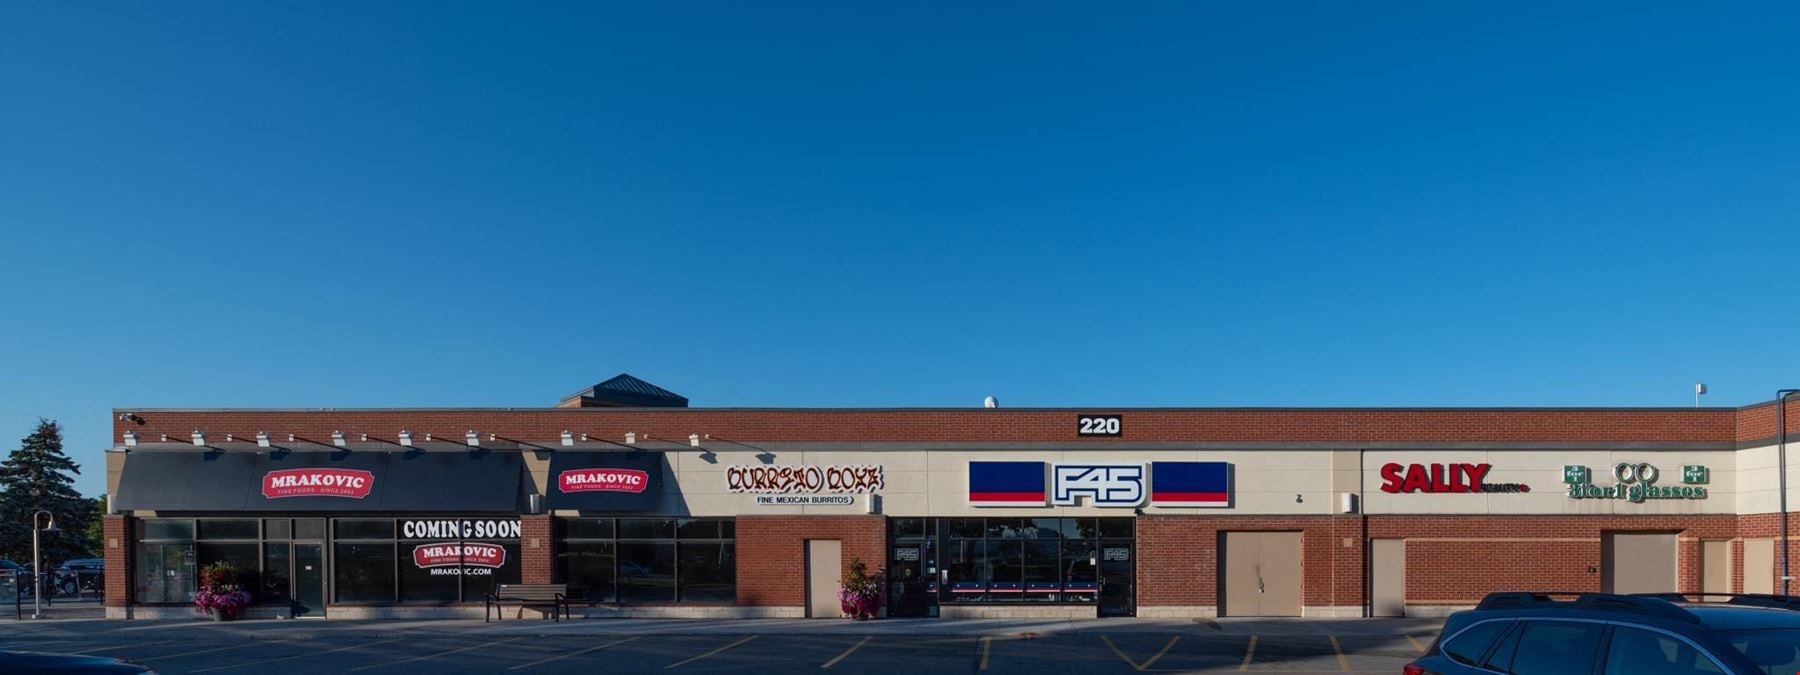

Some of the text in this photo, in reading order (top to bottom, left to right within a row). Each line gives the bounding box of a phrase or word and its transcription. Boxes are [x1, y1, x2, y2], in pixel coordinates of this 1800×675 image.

[1080, 418, 1120, 434] 220
[271, 474, 365, 488] MRAKOVIC
[566, 473, 641, 485] MRAKOVIC
[827, 467, 879, 490] BOYZ
[1054, 465, 1142, 503] F45
[1380, 463, 1490, 493] SALLY
[1627, 481, 1705, 501] glasses
[757, 496, 848, 504] FINE MEXICAN BURRITOS
[403, 520, 522, 538] COMING SOON
[895, 548, 920, 560] F45
[1104, 548, 1128, 560] F45
